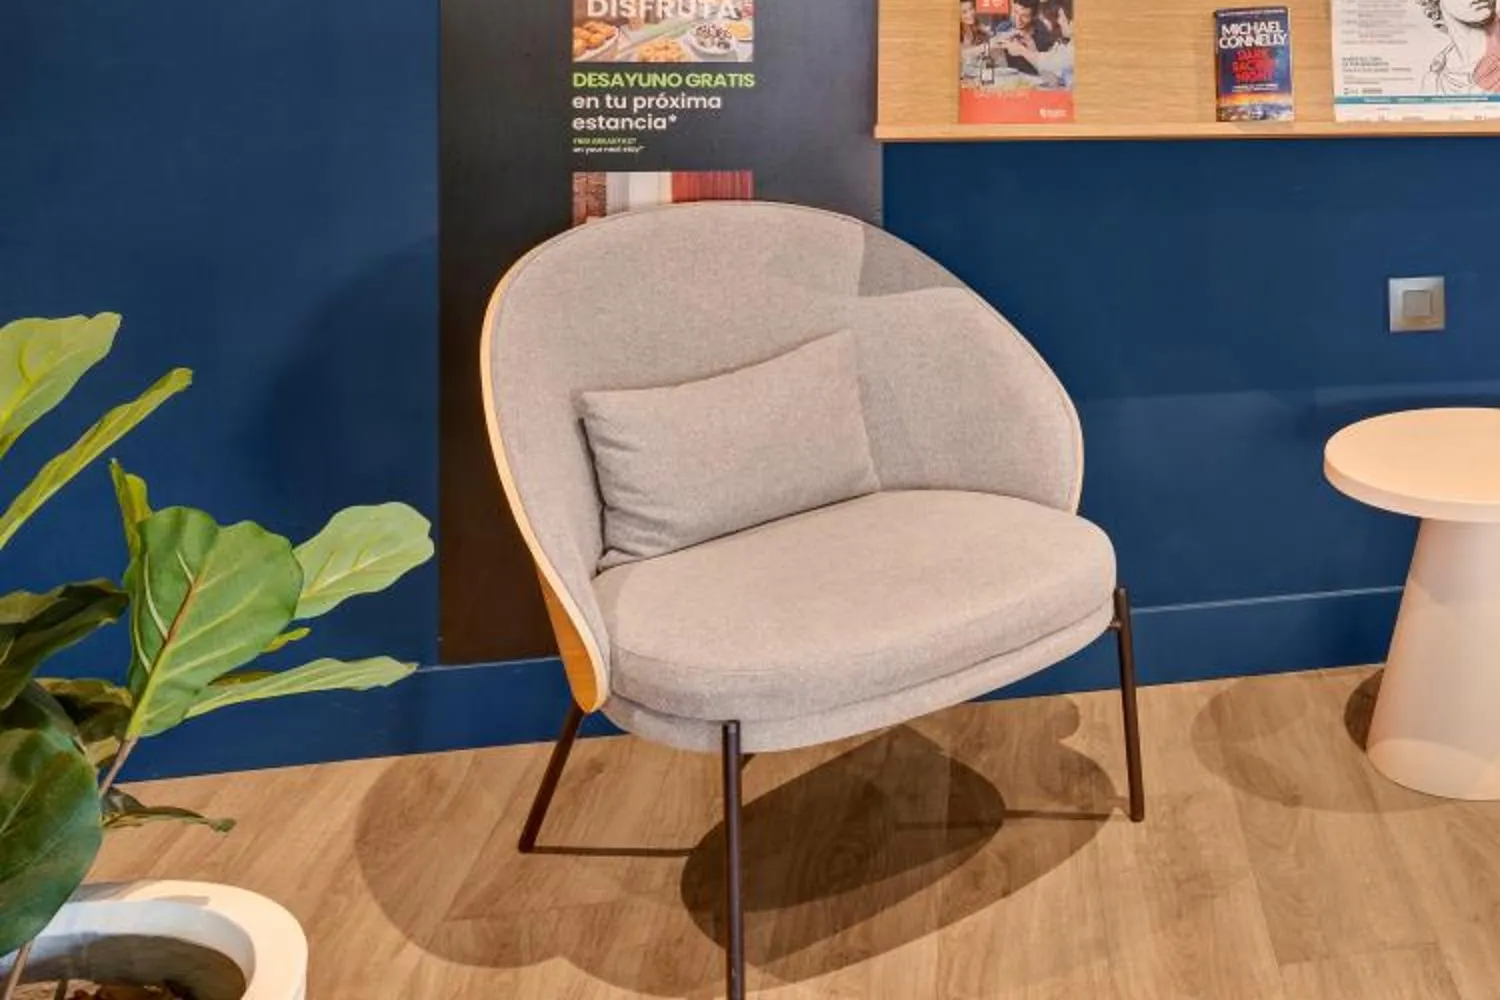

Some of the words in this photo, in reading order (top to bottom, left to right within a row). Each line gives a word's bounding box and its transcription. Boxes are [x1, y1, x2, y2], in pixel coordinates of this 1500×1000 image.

[1221, 20, 1284, 36] MICHAEL
[1219, 33, 1287, 48] CONNELLY
[573, 72, 682, 88] DESAYUNO
[685, 73, 756, 88] GRATIS
[572, 95, 600, 109] en
[605, 93, 627, 109] tu
[633, 92, 721, 112] próxima
